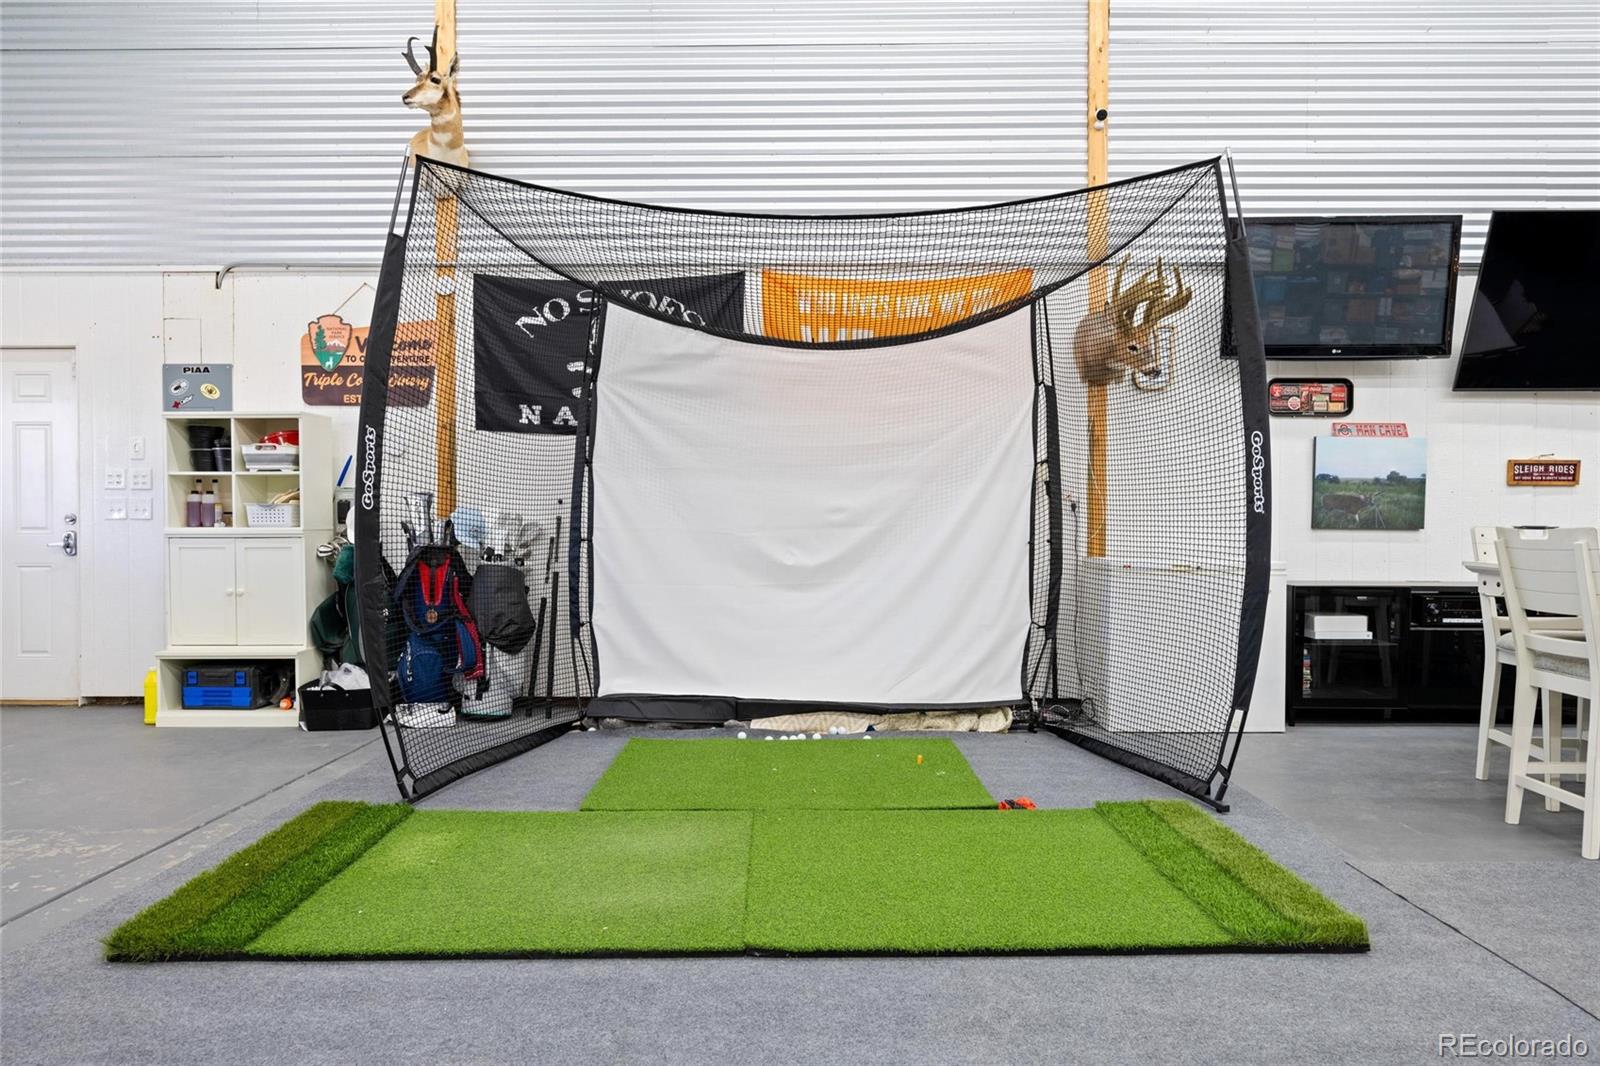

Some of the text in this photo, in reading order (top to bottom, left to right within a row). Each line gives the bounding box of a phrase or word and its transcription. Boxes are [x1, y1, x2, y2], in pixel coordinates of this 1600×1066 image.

[515, 298, 570, 338] NO
[182, 366, 210, 374] PIAA
[304, 372, 343, 390] Triple
[1356, 424, 1376, 436] MAN
[1379, 424, 1404, 436] CAVE
[361, 428, 376, 510] GoSports
[1251, 430, 1265, 513] GoSports
[1514, 464, 1575, 474] SLEIGH RIDES
